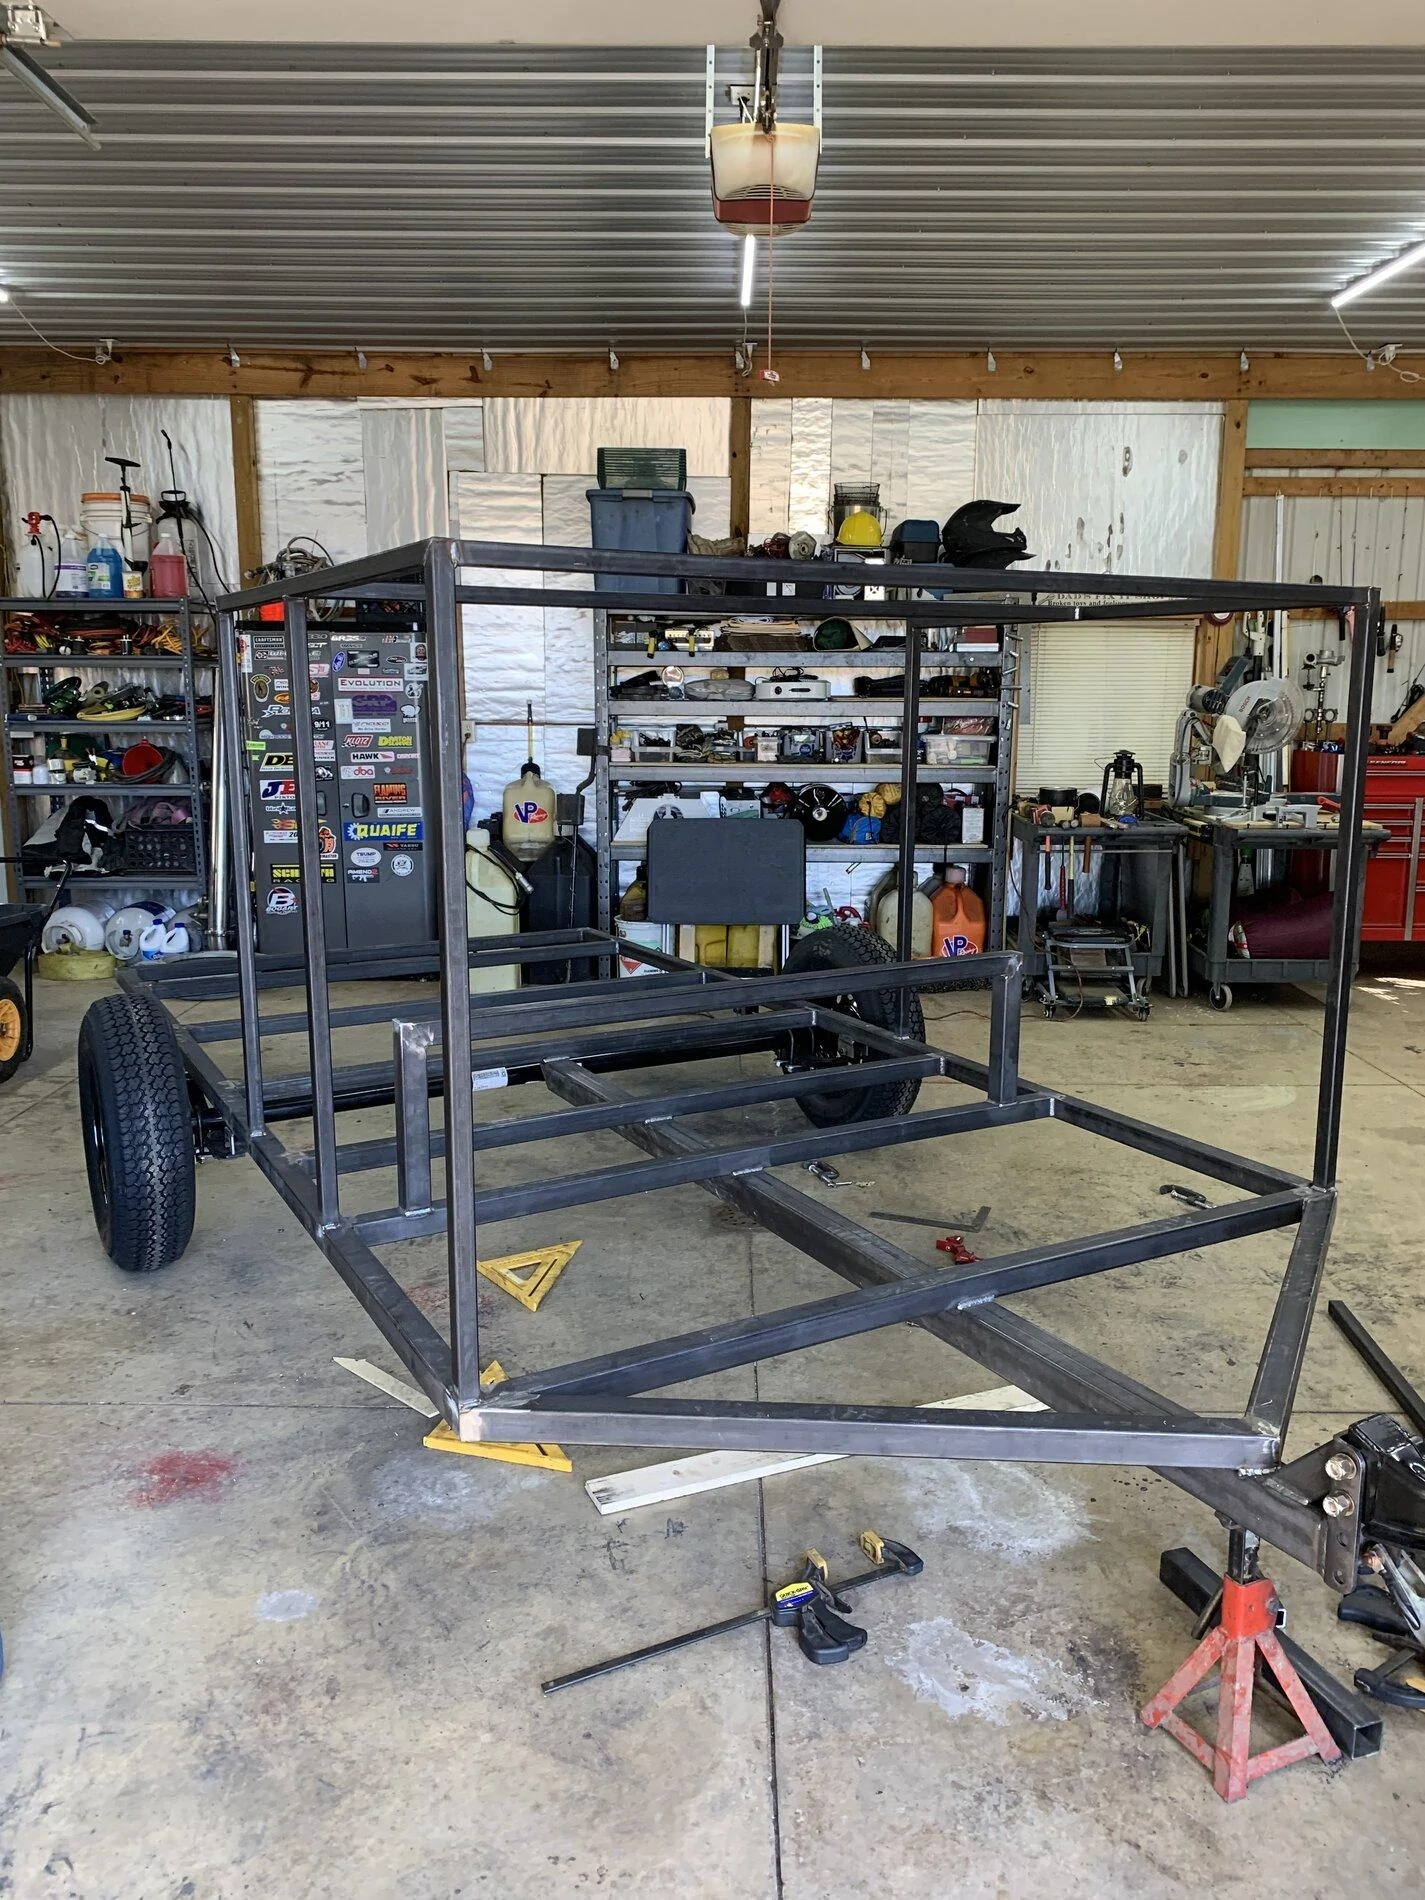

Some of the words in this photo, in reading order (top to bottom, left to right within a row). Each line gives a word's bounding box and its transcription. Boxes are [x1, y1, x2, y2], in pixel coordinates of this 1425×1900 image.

[346, 736, 370, 745] KLOTZ
[514, 801, 539, 824] VP
[355, 823, 418, 838] QUAIFE
